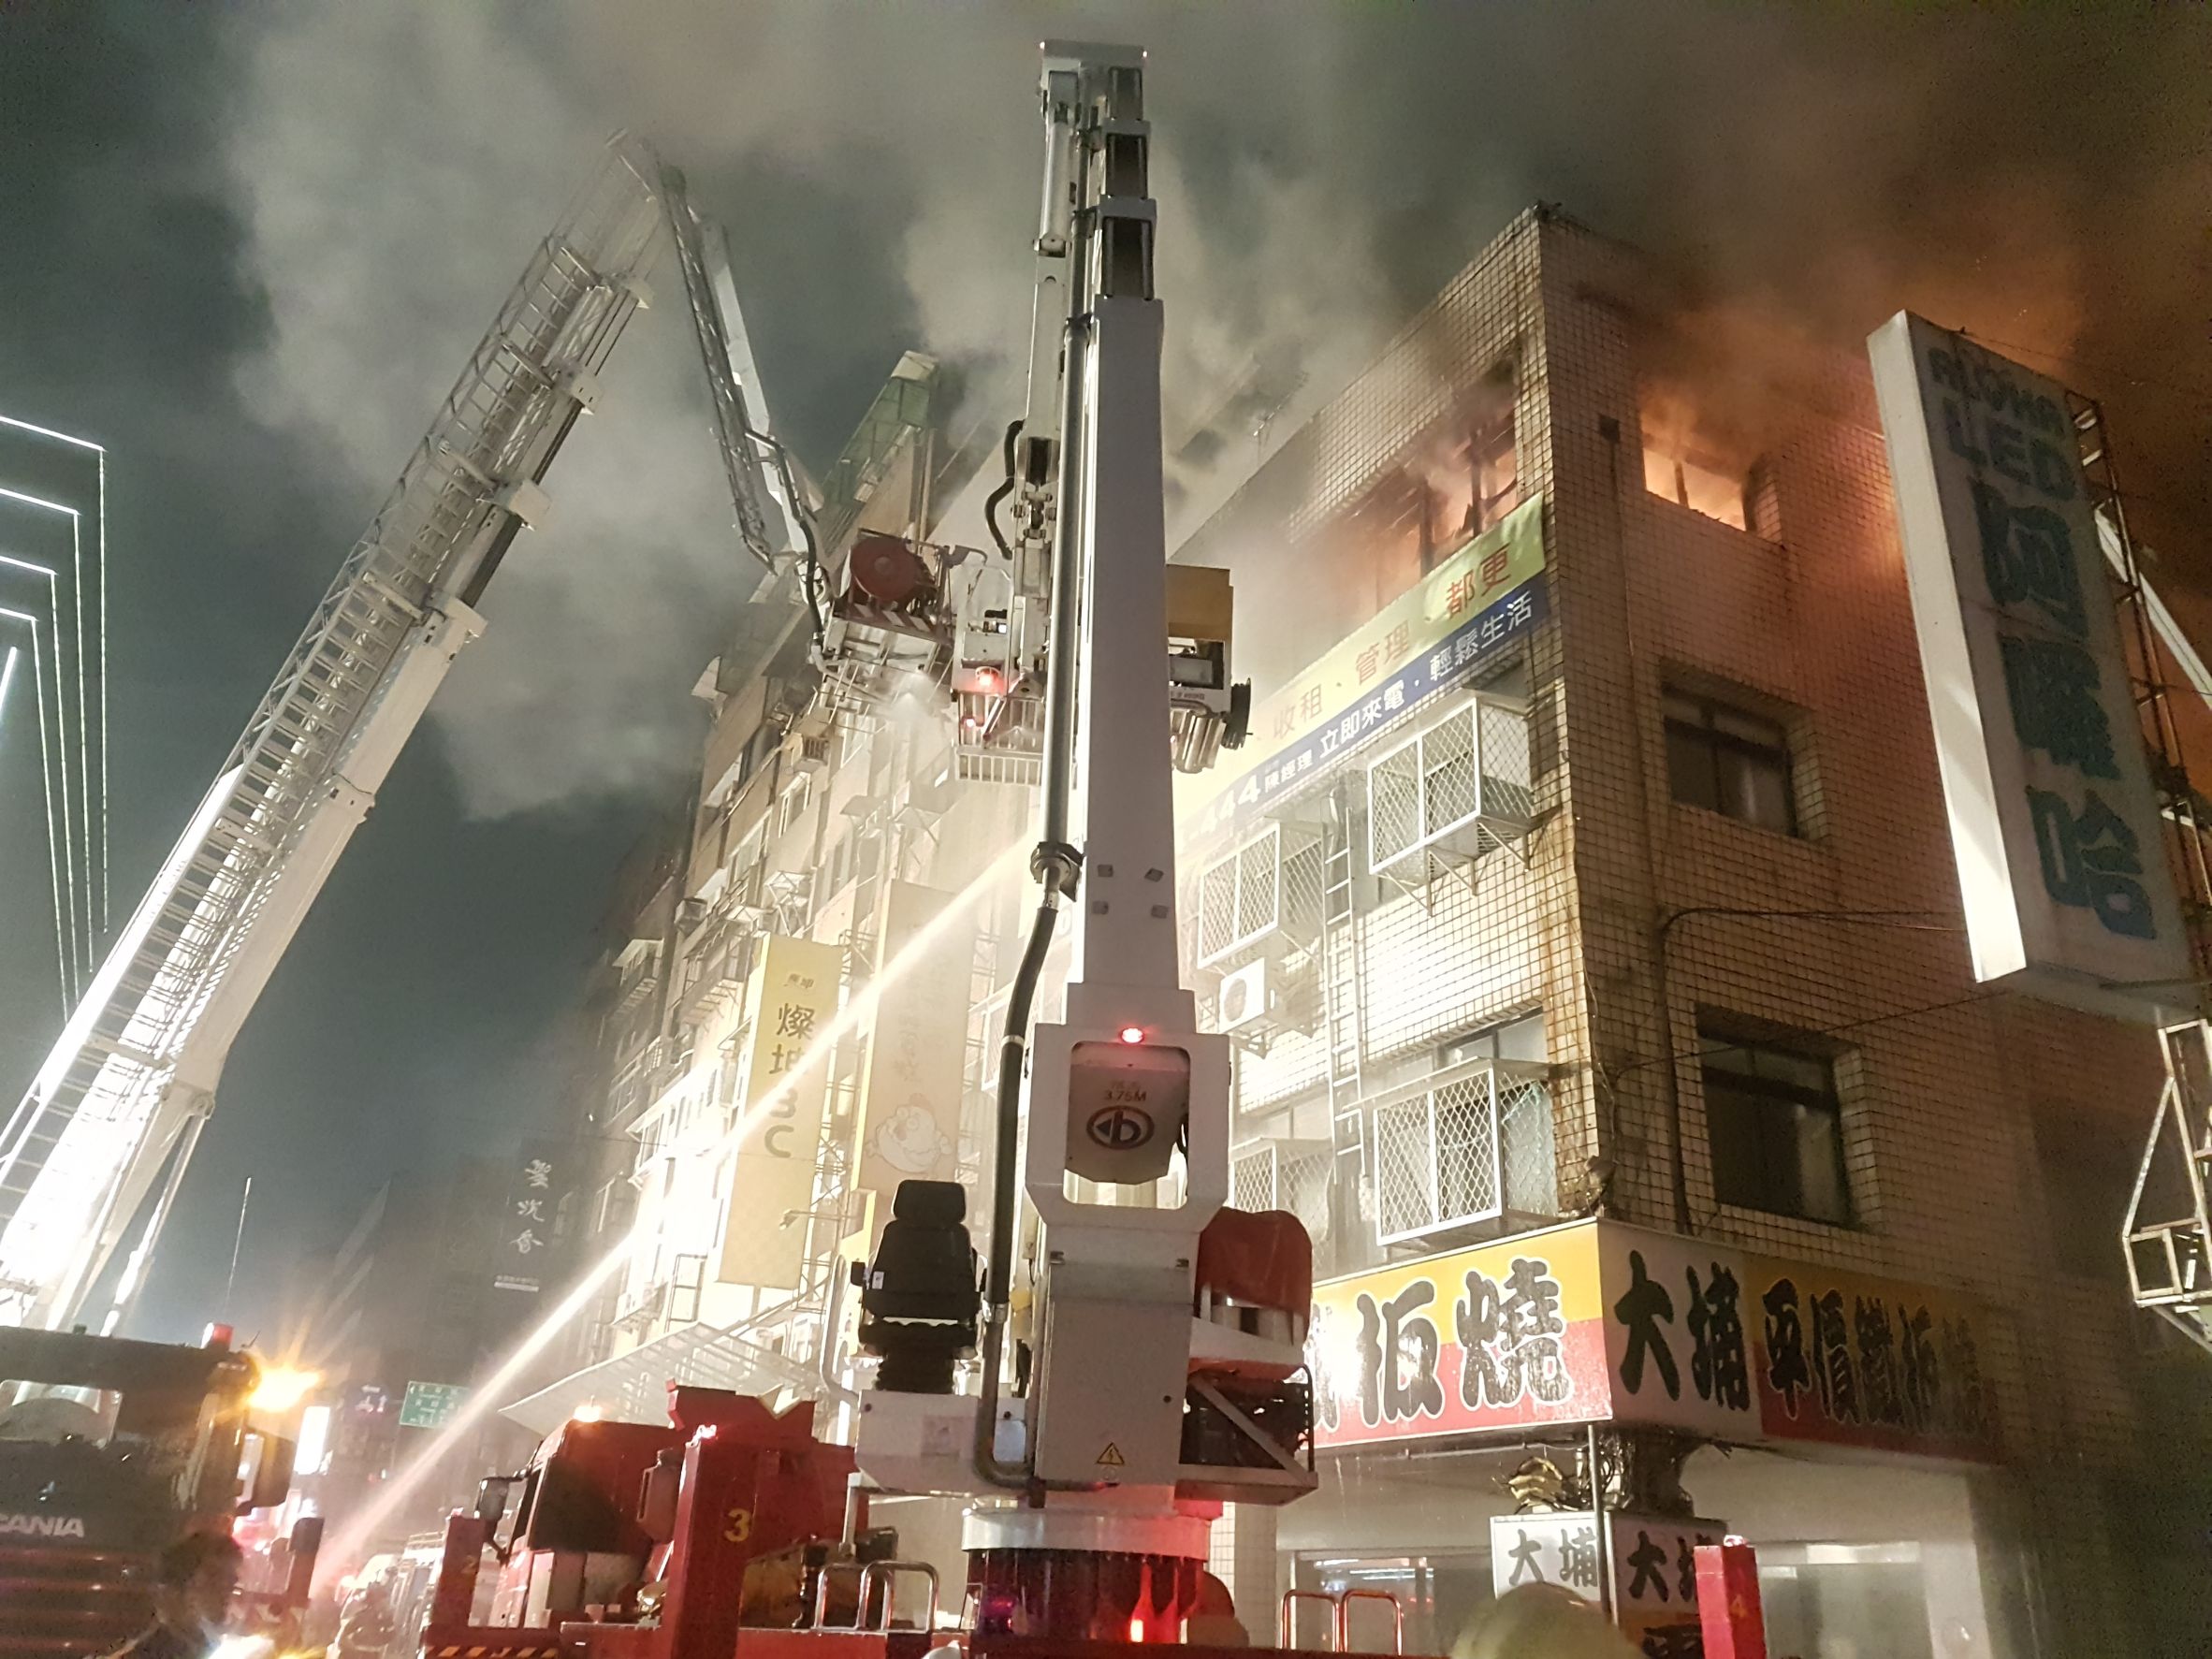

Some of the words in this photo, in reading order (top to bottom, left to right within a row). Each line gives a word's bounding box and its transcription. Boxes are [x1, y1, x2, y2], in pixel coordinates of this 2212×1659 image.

[1943, 397, 2076, 502] LED
[1312, 1258, 1572, 1432] 板燒
[1613, 1250, 1751, 1412] 大埔
[723, 1507, 752, 1542] 3
[1507, 1526, 1599, 1588] 大埔
[1731, 1594, 1749, 1618] 4
